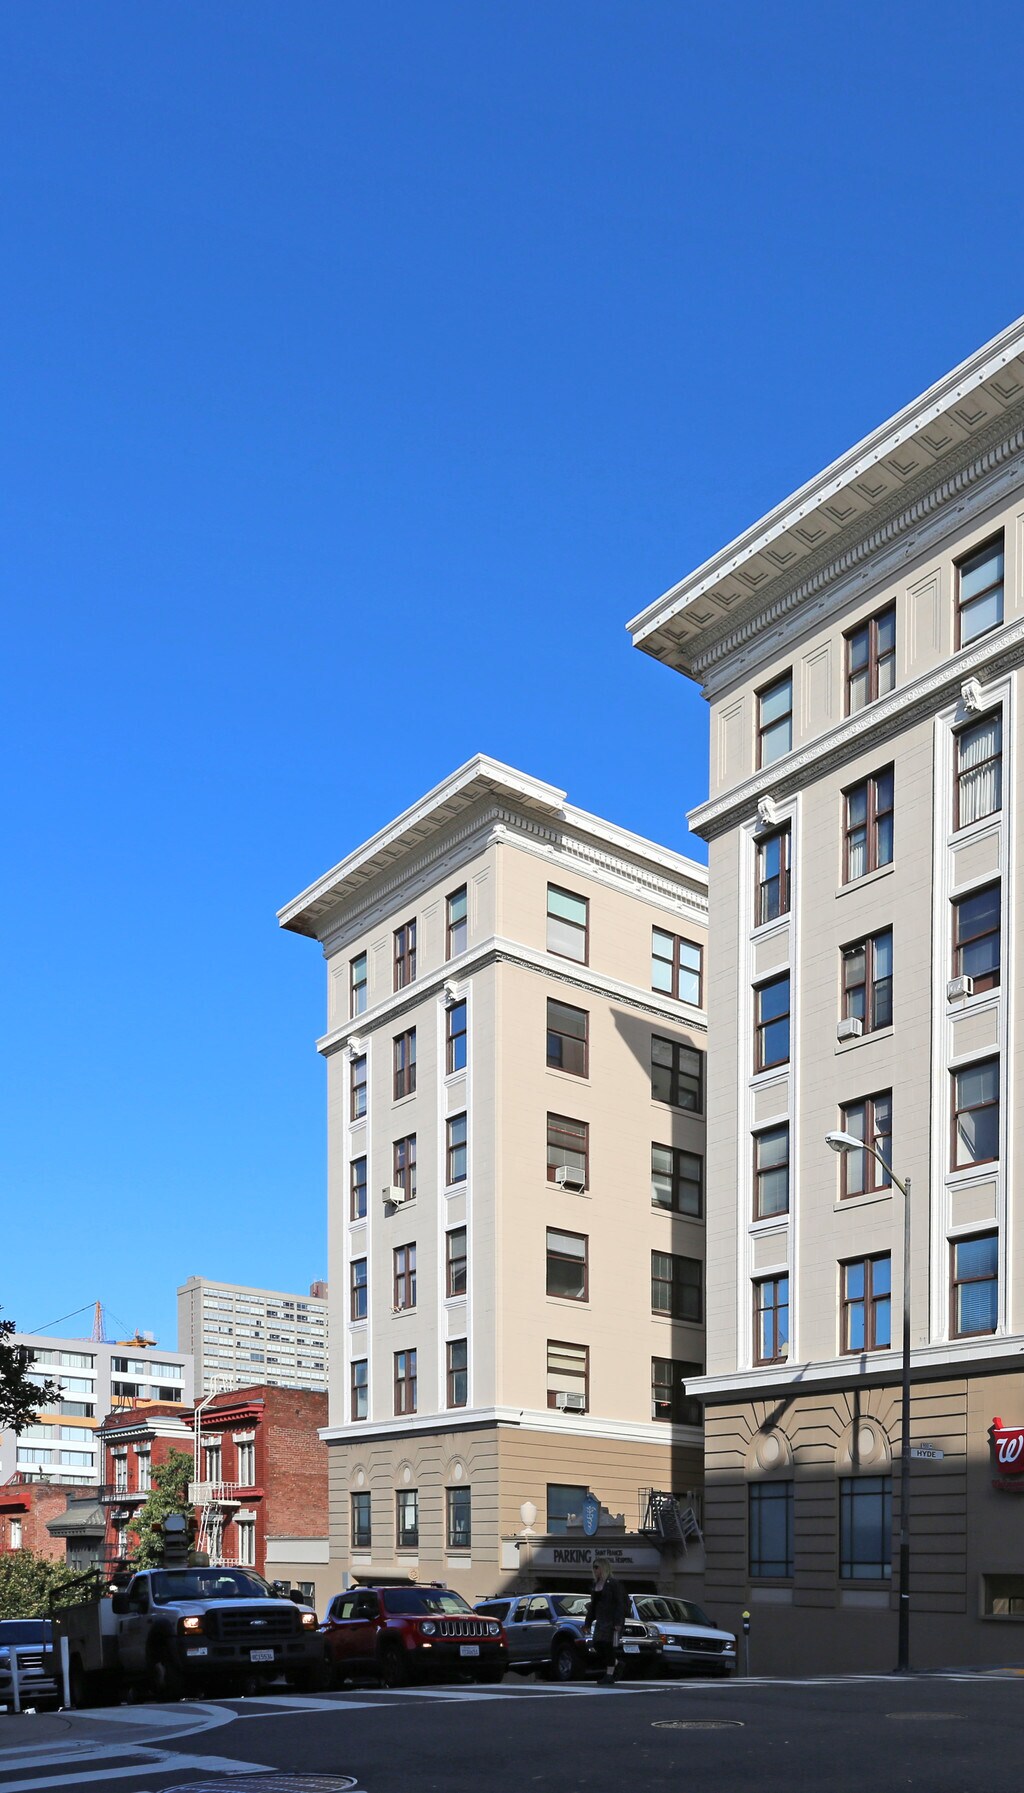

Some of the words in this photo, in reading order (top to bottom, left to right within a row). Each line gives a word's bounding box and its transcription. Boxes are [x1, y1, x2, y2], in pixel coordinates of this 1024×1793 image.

[916, 1450, 936, 1458] HYDE
[996, 1435, 1024, 1463] W
[553, 1549, 592, 1563] PARKING
